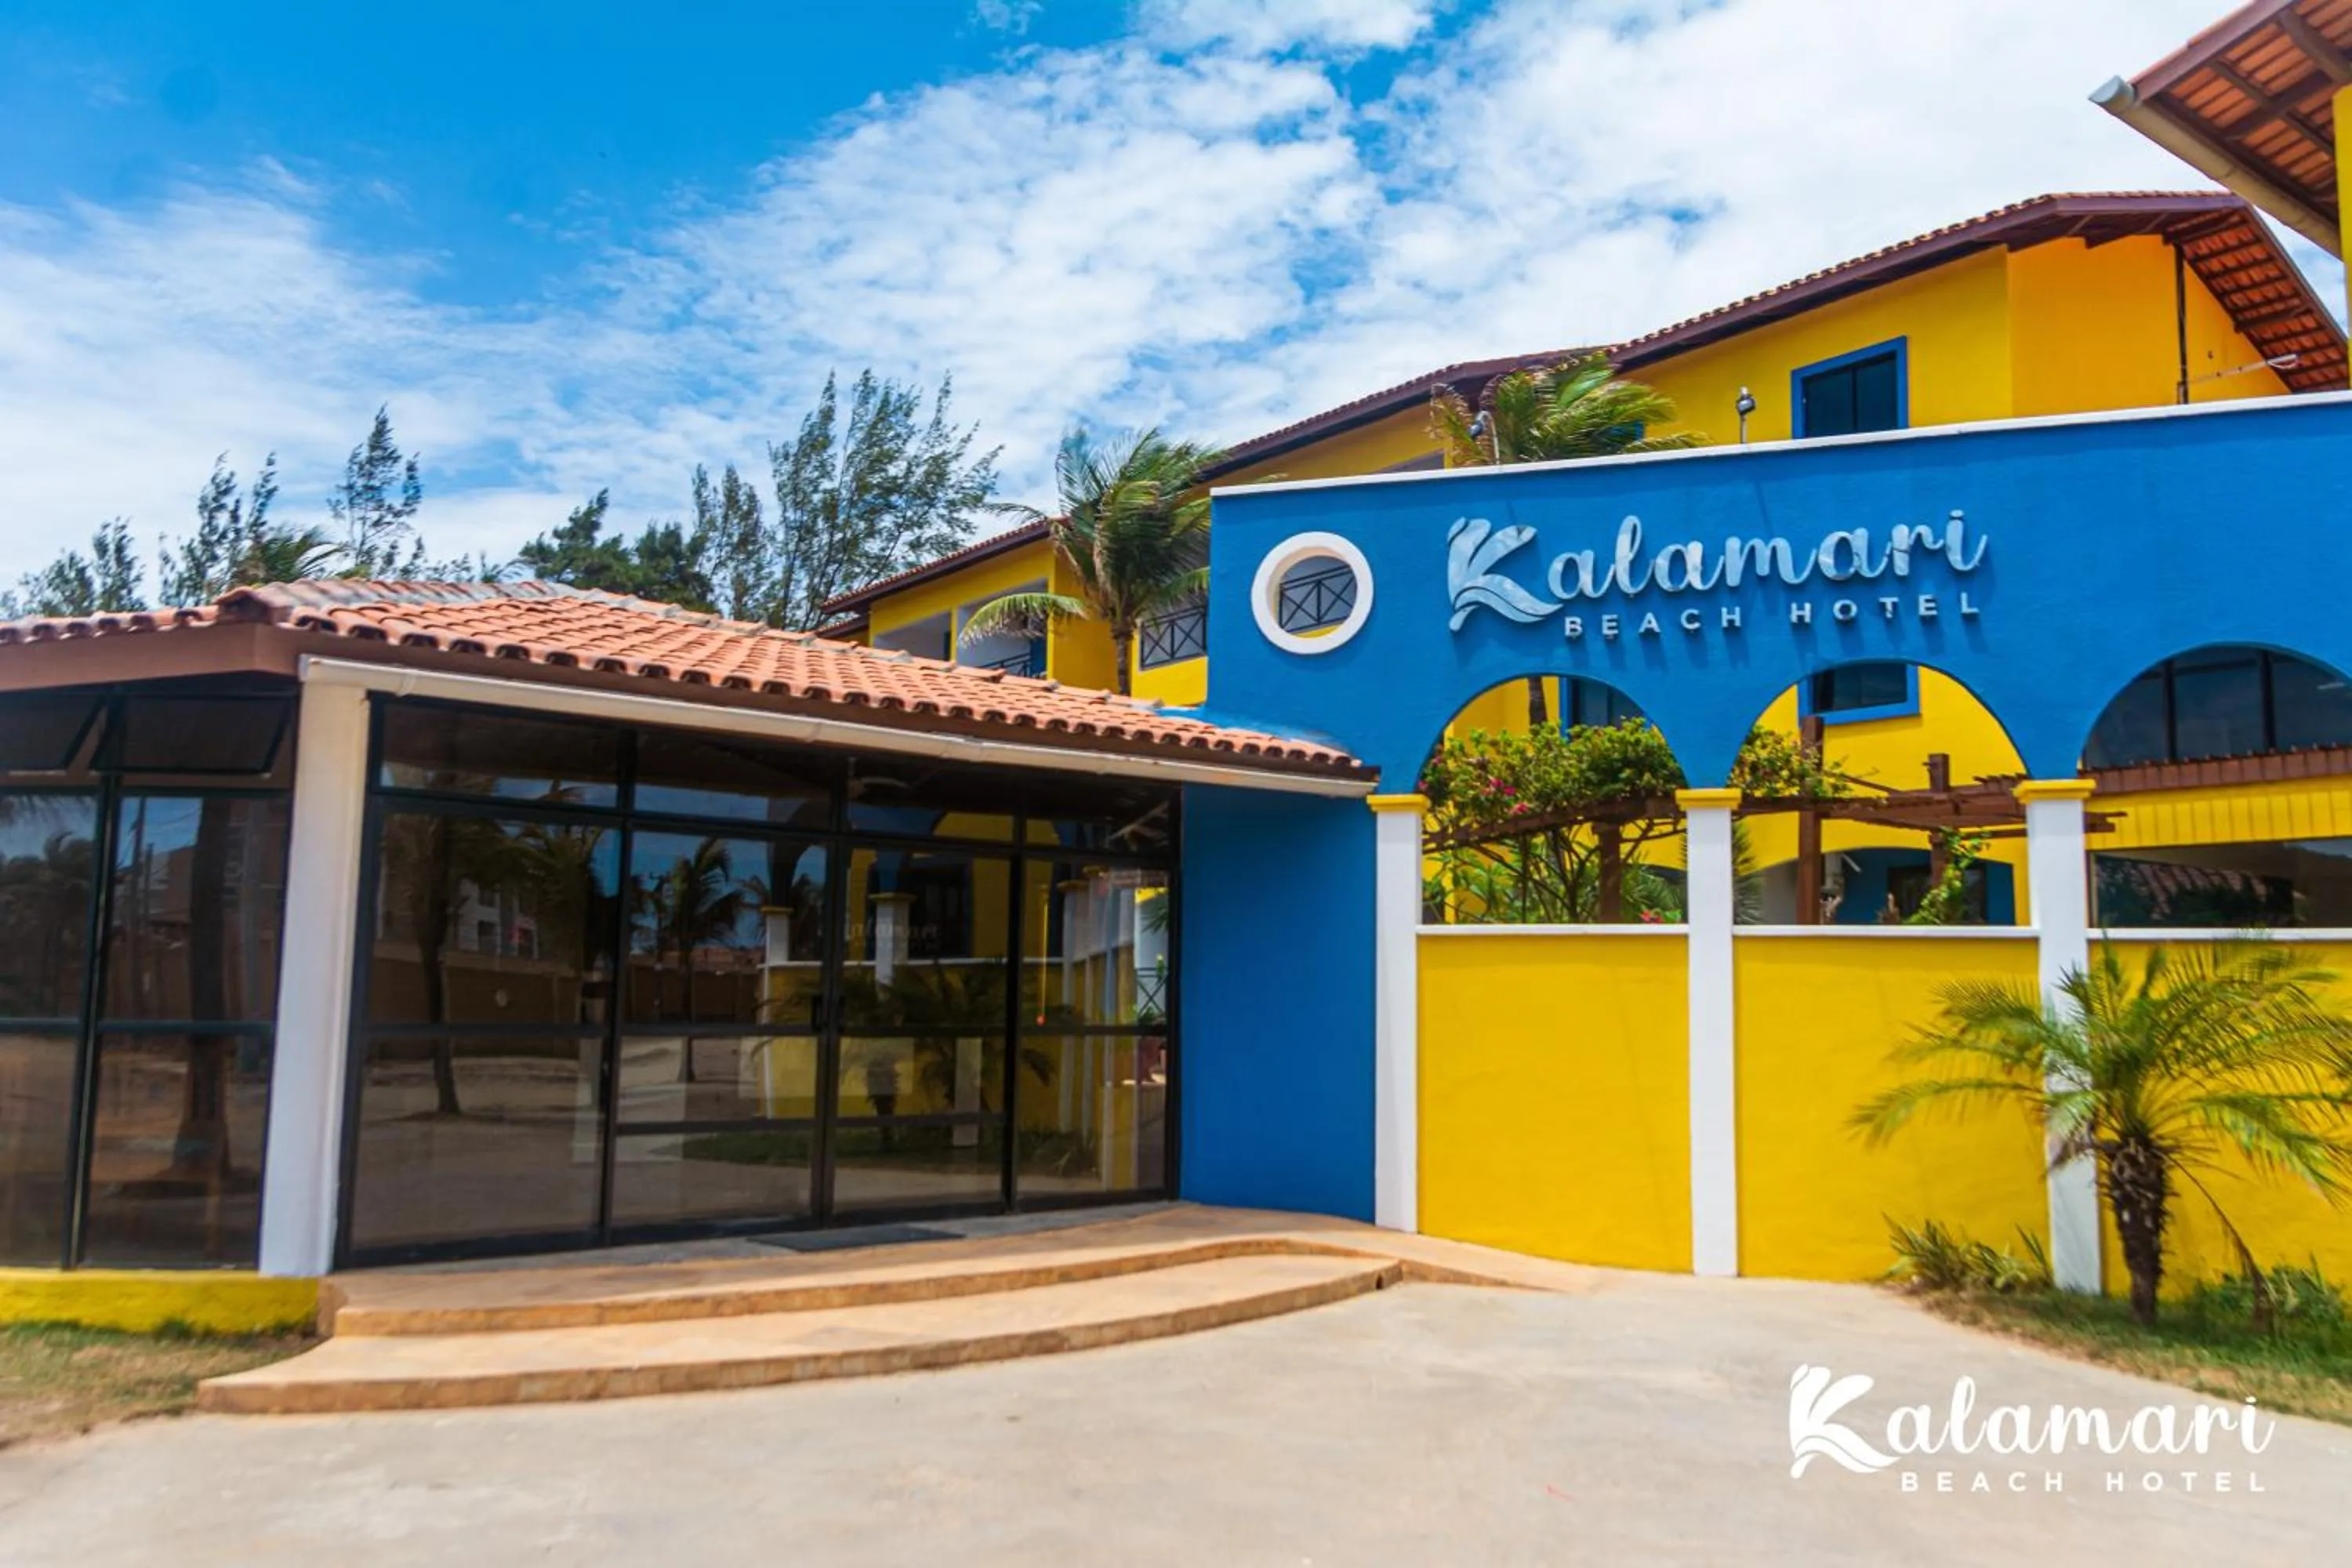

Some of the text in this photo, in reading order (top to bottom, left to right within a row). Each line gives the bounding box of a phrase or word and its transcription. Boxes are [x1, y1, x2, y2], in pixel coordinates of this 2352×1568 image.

[1447, 509, 1988, 632] Kalamari
[1564, 593, 1980, 637] BEACH HOTEL
